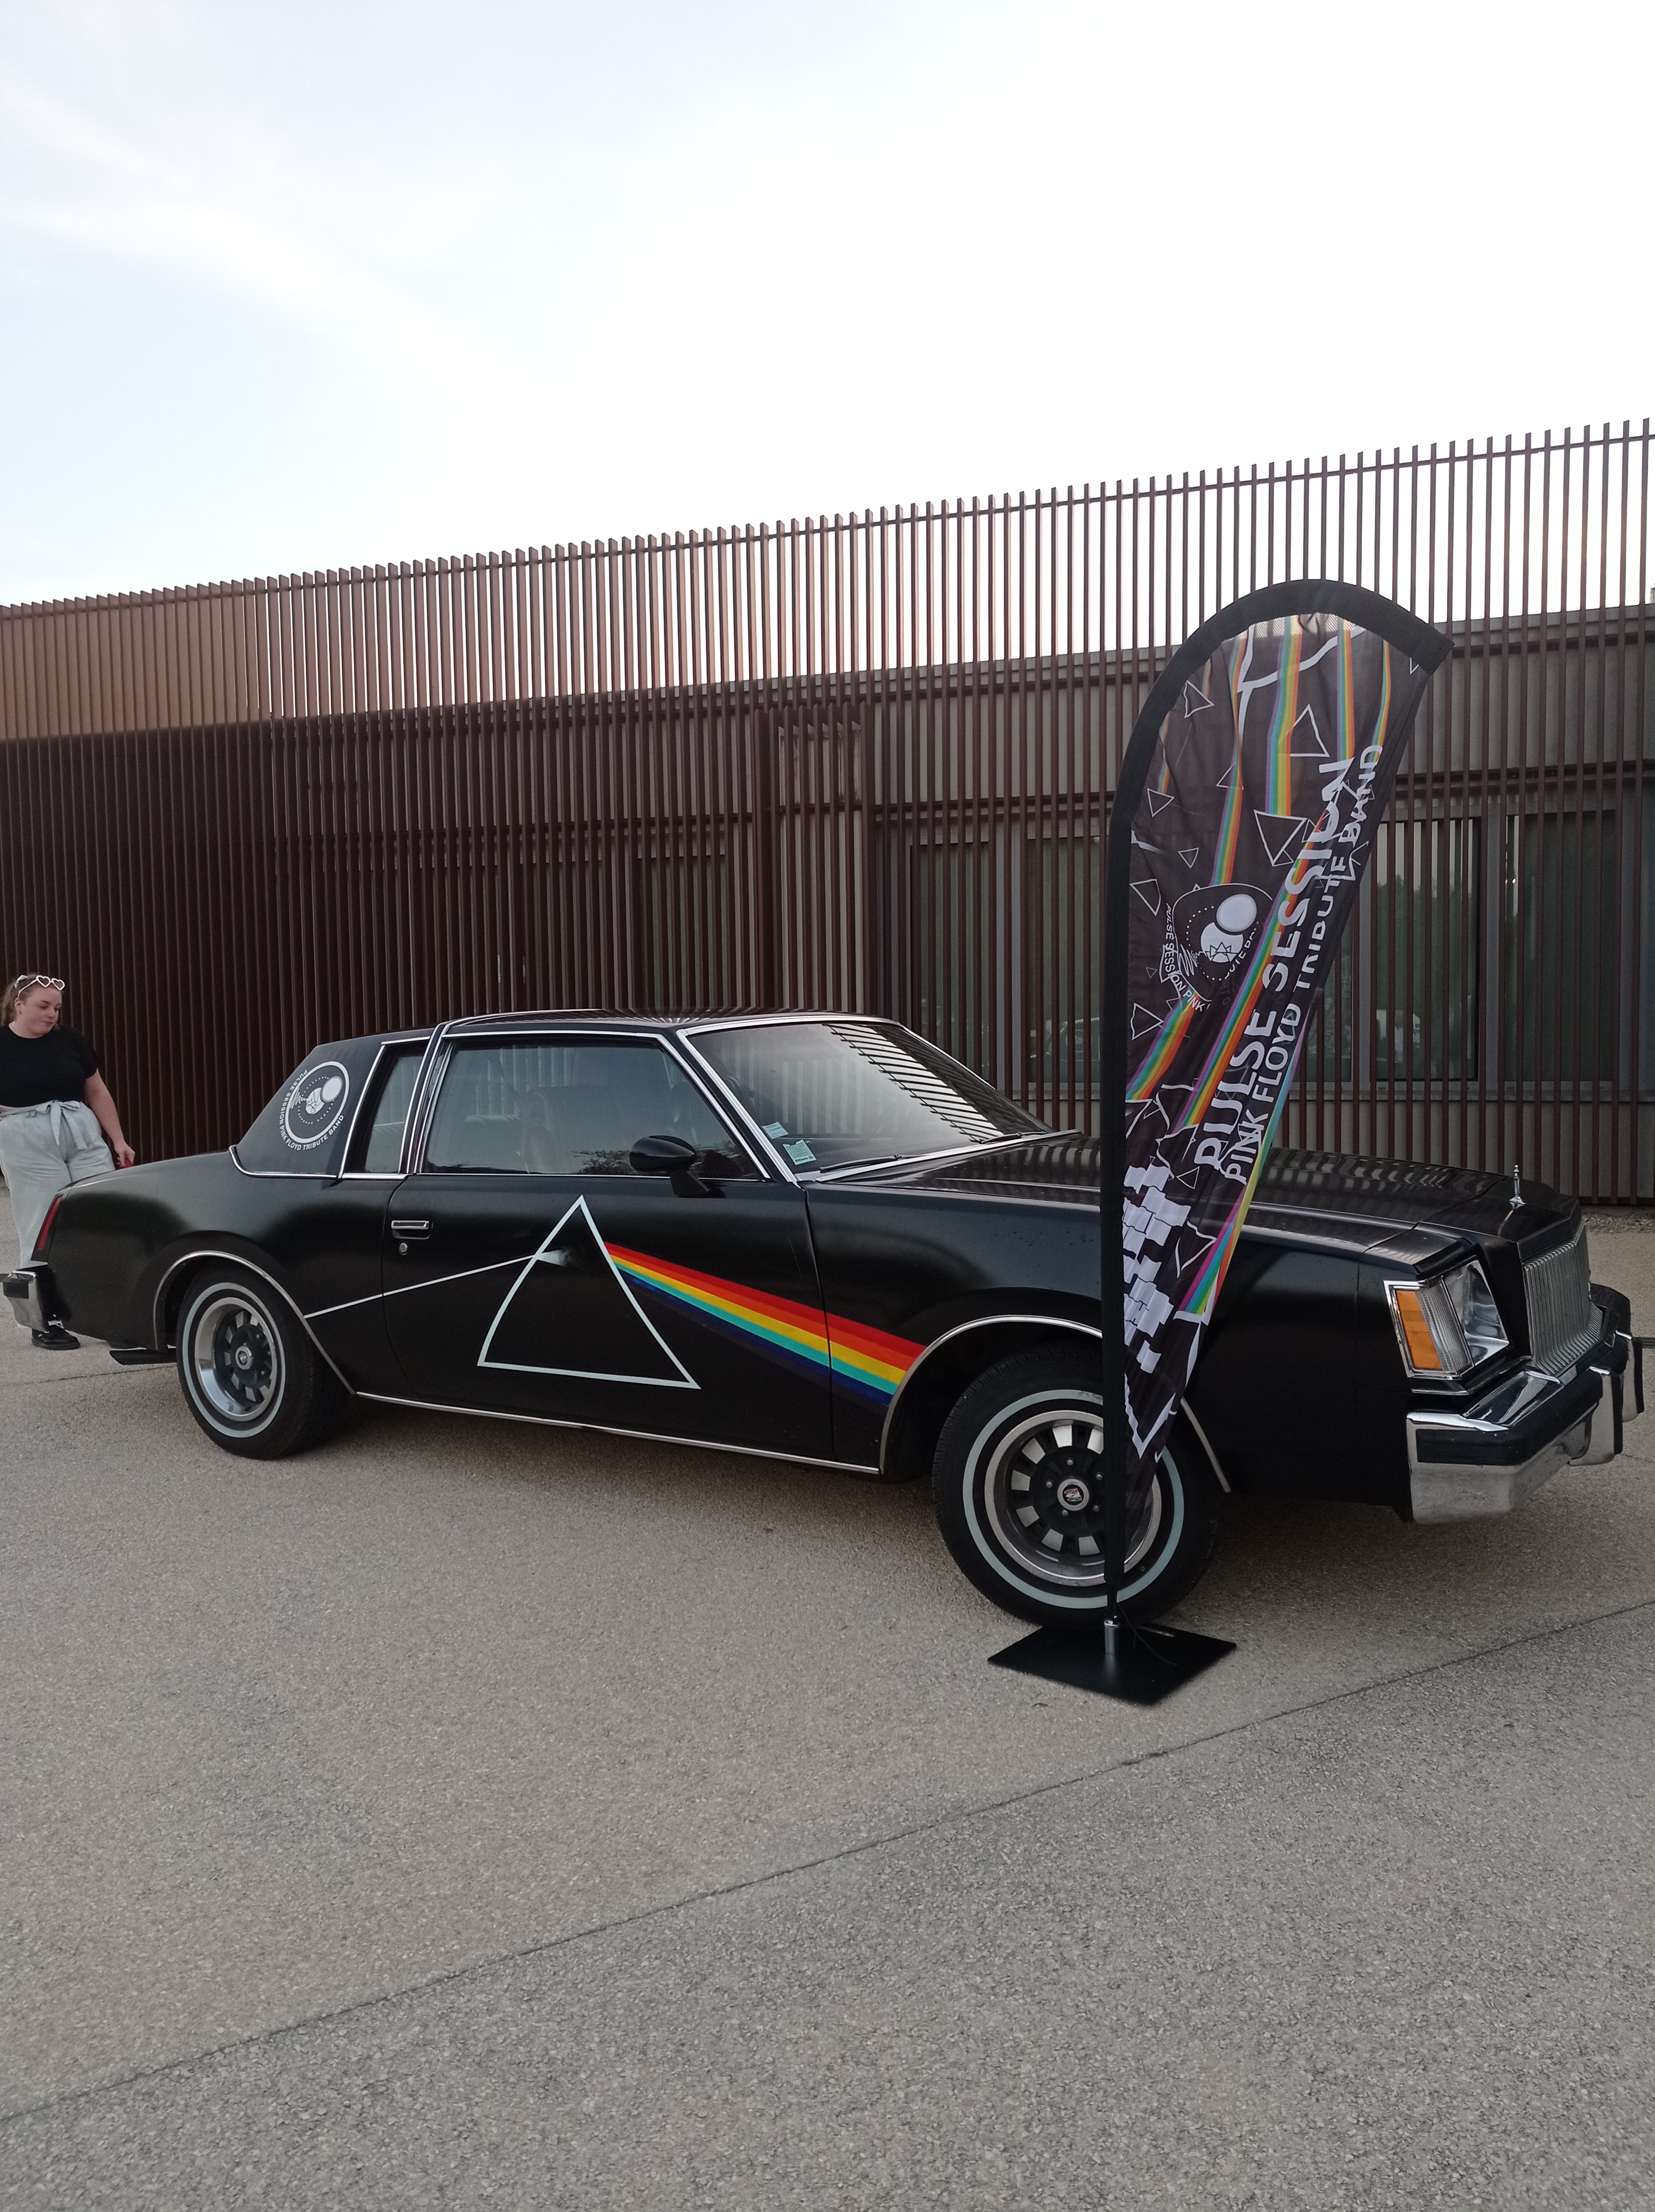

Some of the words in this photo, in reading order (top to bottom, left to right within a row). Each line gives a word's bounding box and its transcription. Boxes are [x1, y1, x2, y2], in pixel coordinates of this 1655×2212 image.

[1165, 902, 1175, 941] PULSE
[1163, 942, 1186, 991] SESSION
[1183, 989, 1206, 1013] PINK
[1223, 1108, 1269, 1185] PINK
[1252, 1003, 1302, 1102] FLOYD
[1293, 855, 1346, 993] TRIBUTE
[290, 1069, 308, 1091] PULSE
[1194, 1009, 1277, 1165] PULSE
[279, 1092, 292, 1125] SESSION
[329, 1114, 345, 1136] BAND
[285, 1138, 302, 1151] FLOYD
[303, 1134, 329, 1151] TRIBUTE
